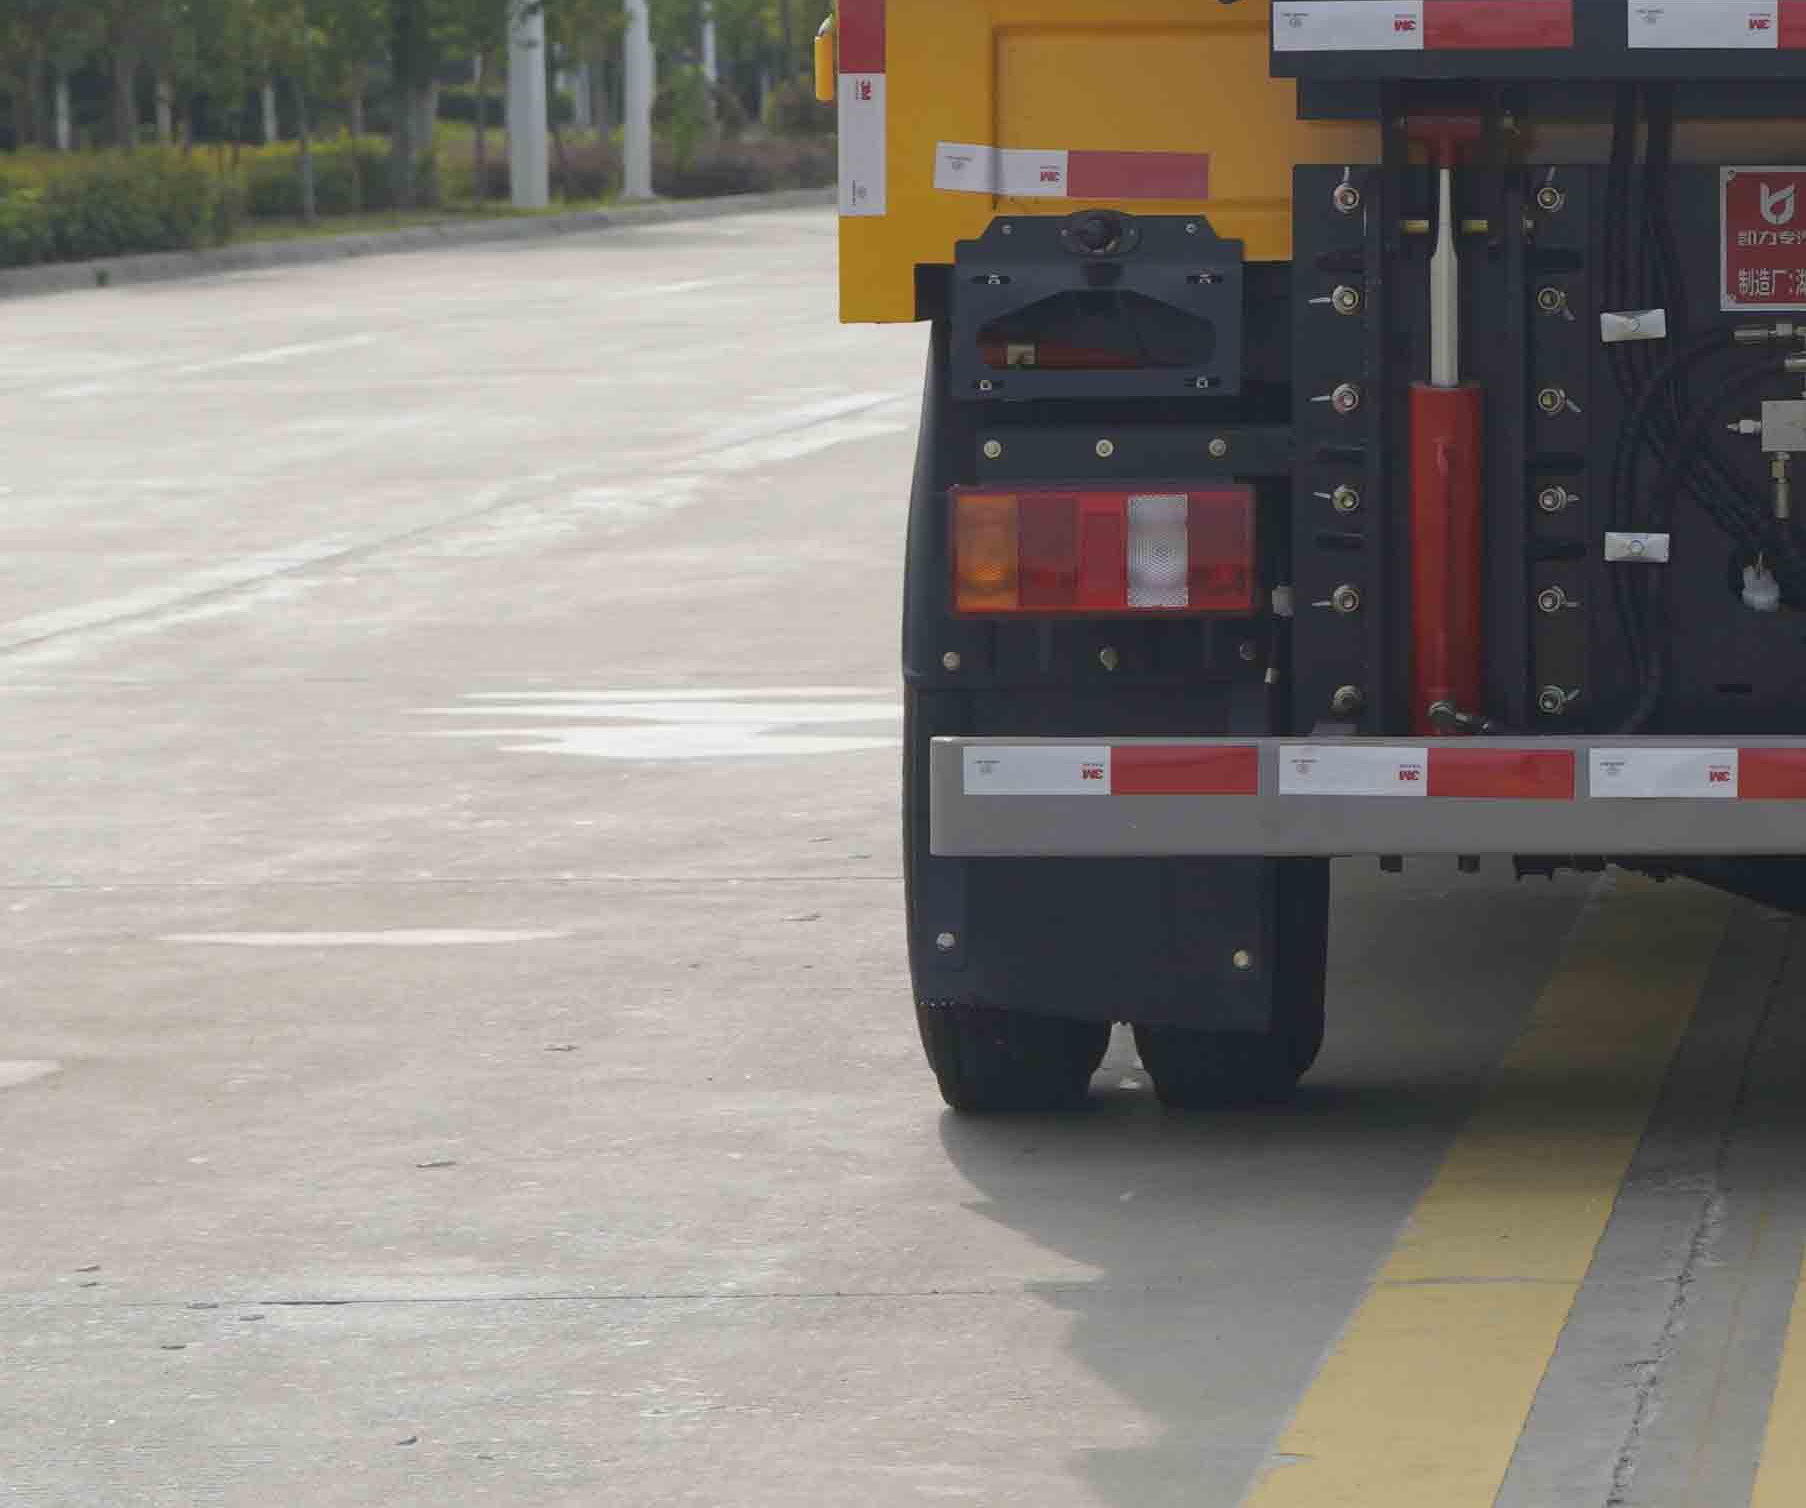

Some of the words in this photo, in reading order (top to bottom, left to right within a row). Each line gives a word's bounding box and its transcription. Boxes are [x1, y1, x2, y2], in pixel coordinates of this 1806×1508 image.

[1392, 18, 1418, 32] 3M
[1747, 17, 1771, 31] 3M
[861, 78, 872, 101] 3M
[1039, 170, 1060, 183] 3M
[1081, 768, 1104, 780] 3M
[1398, 769, 1421, 782] 3M
[1708, 769, 1731, 783] 3M
